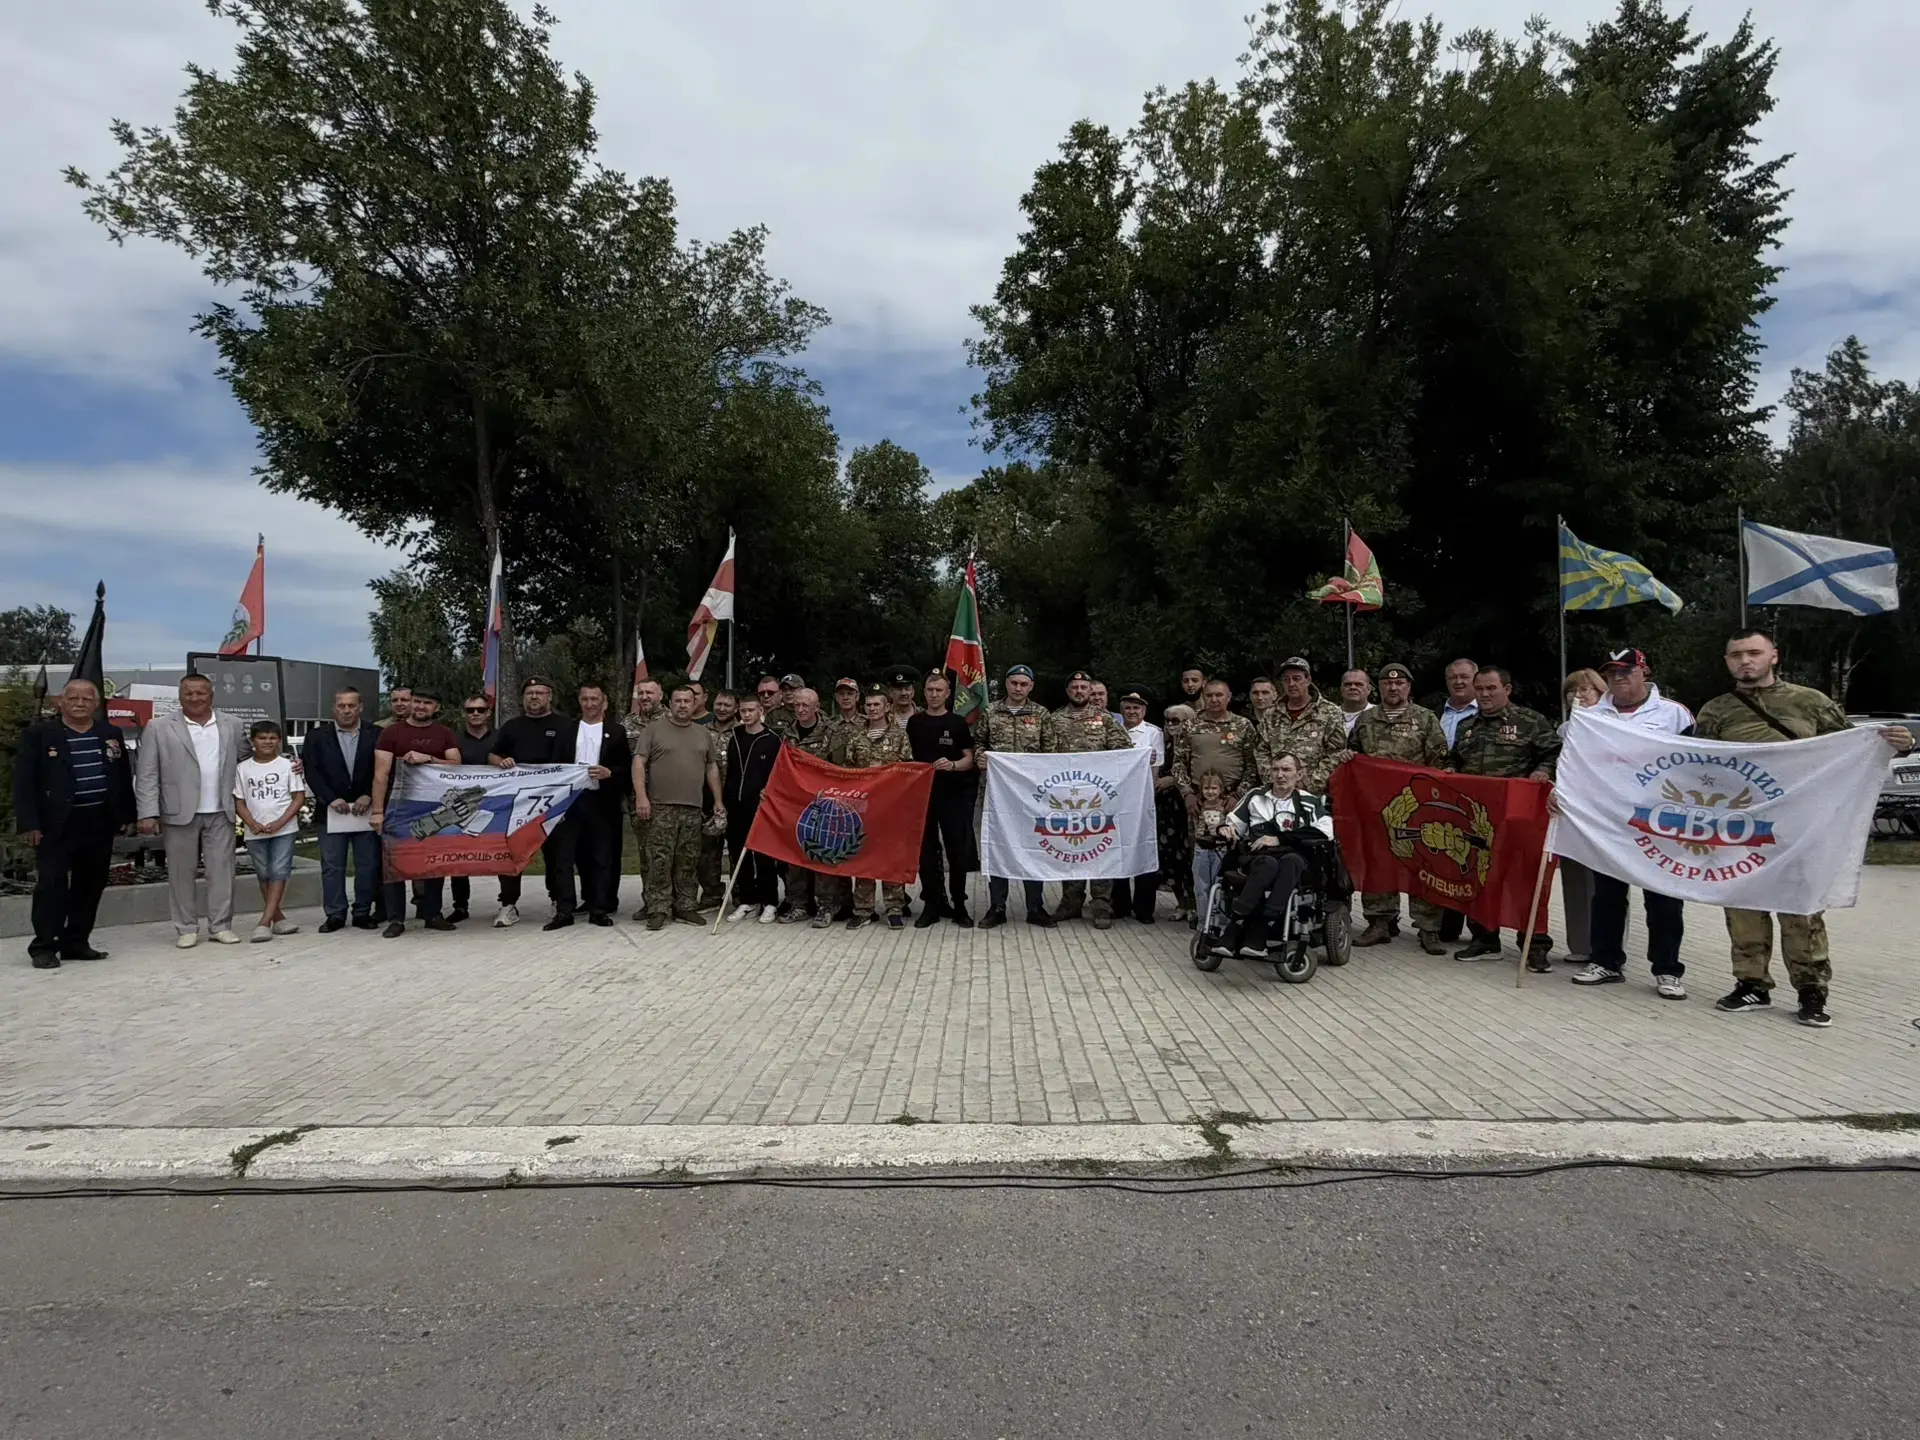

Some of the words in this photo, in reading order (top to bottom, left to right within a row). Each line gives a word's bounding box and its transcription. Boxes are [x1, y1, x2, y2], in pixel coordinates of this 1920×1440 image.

[1032, 770, 1118, 803] АССОЦИАЦИЯ
[1635, 752, 1785, 801] АССОЦИАЦИЯ
[1045, 810, 1107, 835] СВО
[1648, 803, 1755, 844] СВО
[1038, 836, 1113, 864] ВЕТЕРАНОВ
[1634, 835, 1767, 882] ВЕТЕРАНОВ
[1418, 869, 1473, 898] СПЕЦНАЗ
